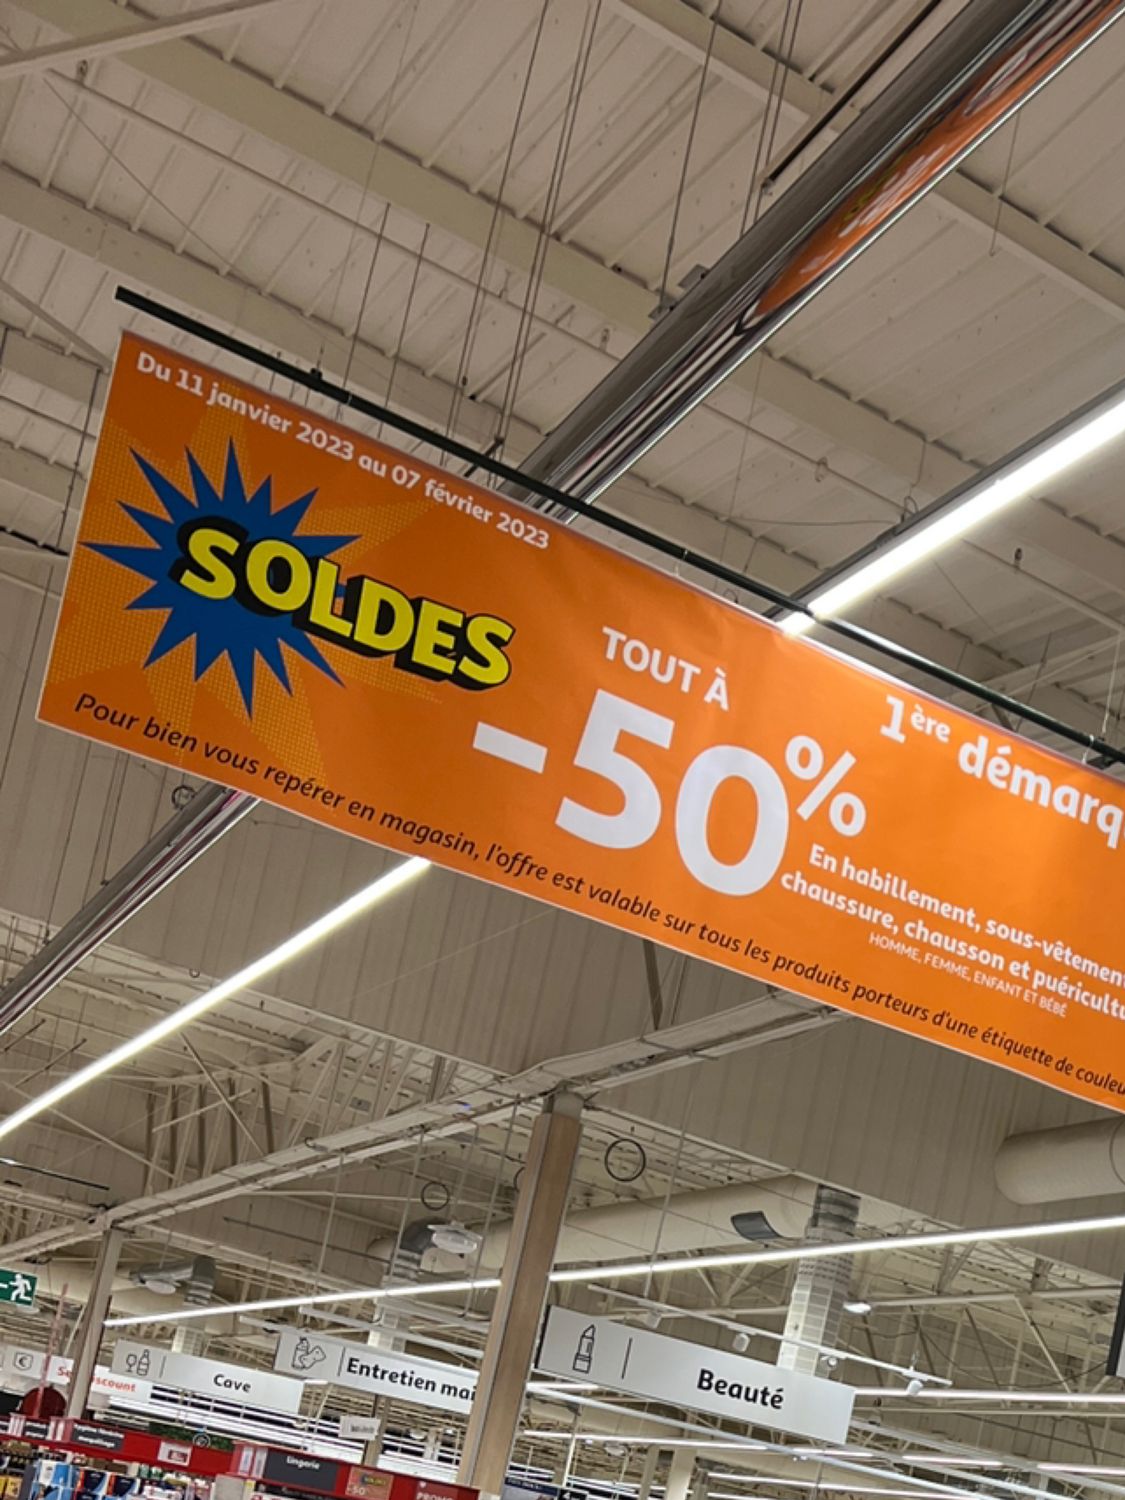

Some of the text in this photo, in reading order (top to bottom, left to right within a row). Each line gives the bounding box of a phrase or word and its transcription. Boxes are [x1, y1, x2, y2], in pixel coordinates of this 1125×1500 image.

[136, 351, 551, 550] Du 11 janvier 2023 au 07 février 2023
[174, 520, 516, 688] SOLDES
[601, 626, 729, 711] TOUT À
[879, 694, 951, 743] 1ère
[74, 693, 139, 732] Pour
[142, 712, 197, 752] bien
[203, 743, 259, 776] vous
[262, 764, 346, 810] repérer
[347, 797, 375, 821] en
[379, 813, 481, 861] magasin,
[484, 845, 549, 883] l'offre
[551, 871, 584, 896] est
[588, 885, 661, 922] valable
[664, 912, 696, 935] sur
[698, 923, 740, 952] tous
[743, 937, 771, 963] les
[773, 951, 850, 994] produits
[852, 984, 929, 1022] porteurs
[932, 1010, 979, 1039] d'une
[981, 1024, 1053, 1068] étiquette
[1055, 1052, 1074, 1076] de
[780, 870, 899, 935] chaussure,
[903, 918, 1005, 971] chausson
[1008, 959, 1030, 980] et
[808, 843, 837, 873] En
[841, 855, 982, 933] habillement,
[869, 932, 1068, 1018] HOMME, FEMME, ENFANT ET BÉBÉ
[213, 1373, 251, 1394] Cave
[347, 1357, 477, 1400] Entretien mai
[697, 1368, 784, 1410] Beauté
[286, 1455, 320, 1471] Lingerie
